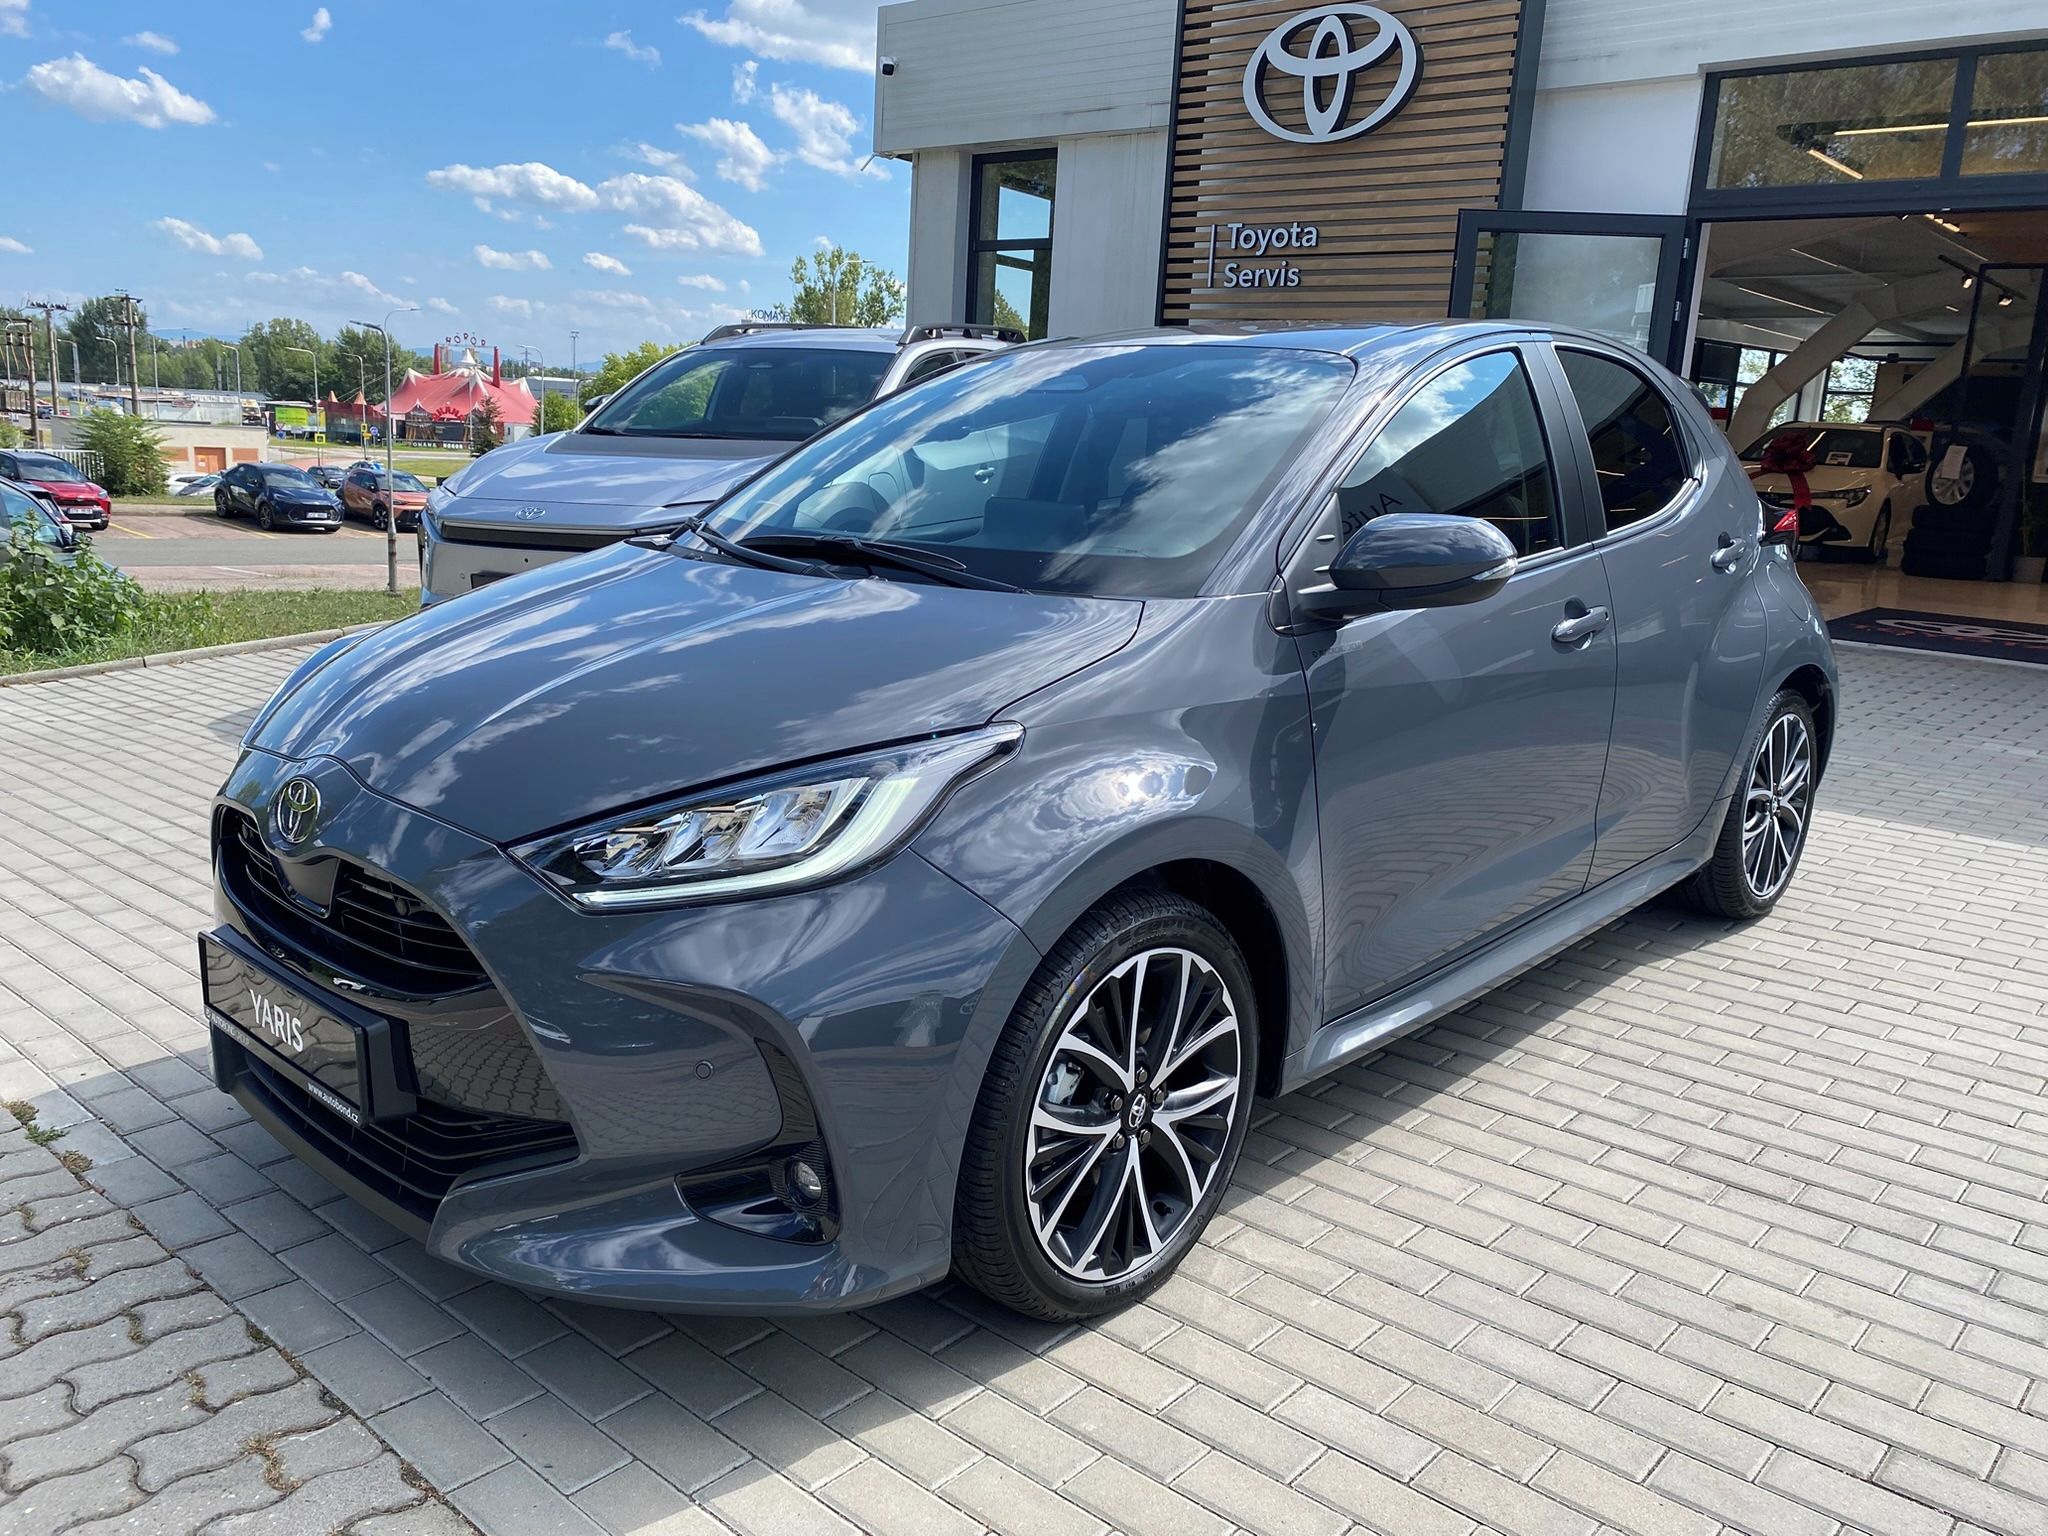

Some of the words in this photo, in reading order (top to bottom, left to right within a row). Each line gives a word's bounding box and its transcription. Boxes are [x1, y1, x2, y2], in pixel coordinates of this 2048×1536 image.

[1227, 222, 1318, 256] Toyota
[1223, 260, 1300, 288] Servis
[250, 988, 304, 1052] YARIS
[307, 1082, 359, 1124] www.autobond.cz
